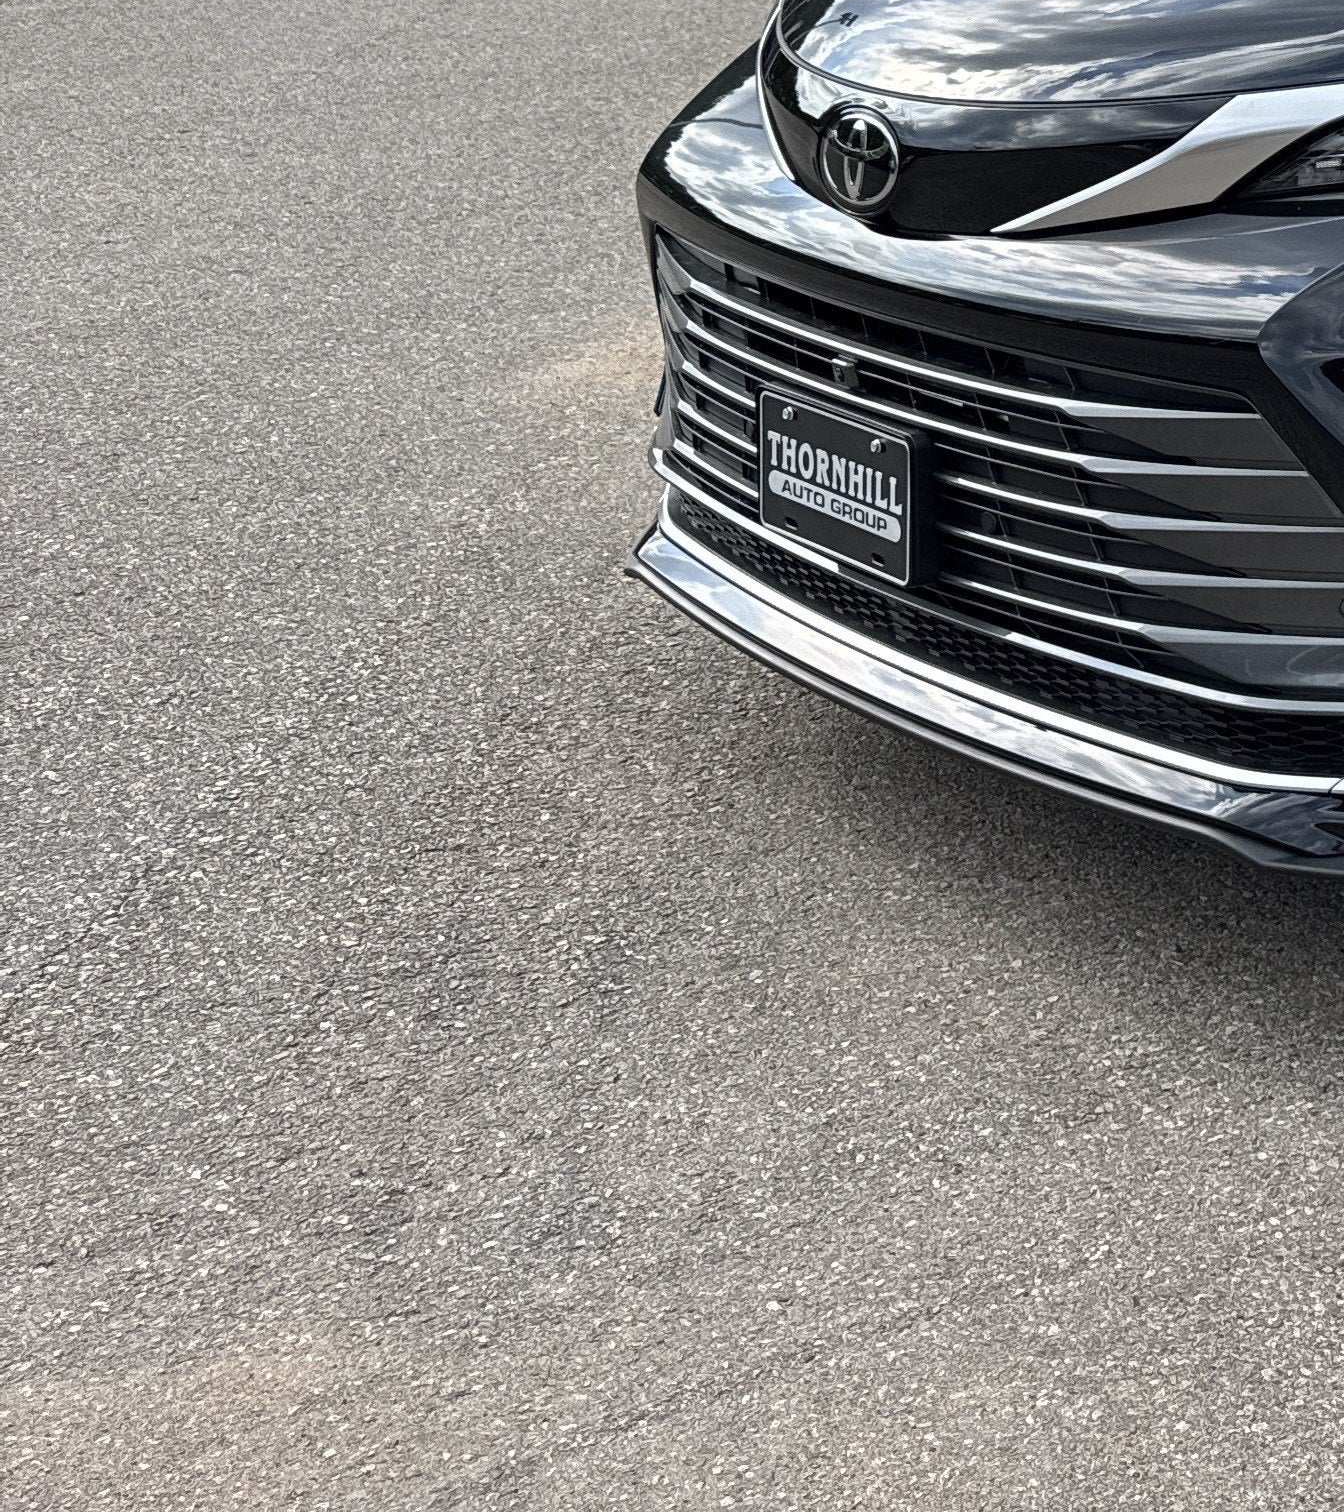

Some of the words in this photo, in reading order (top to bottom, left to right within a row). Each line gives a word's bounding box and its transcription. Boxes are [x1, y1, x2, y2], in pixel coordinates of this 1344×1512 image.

[767, 430, 903, 516] THORNHILL
[781, 479, 825, 508] AUTO
[830, 498, 888, 532] GROUP
